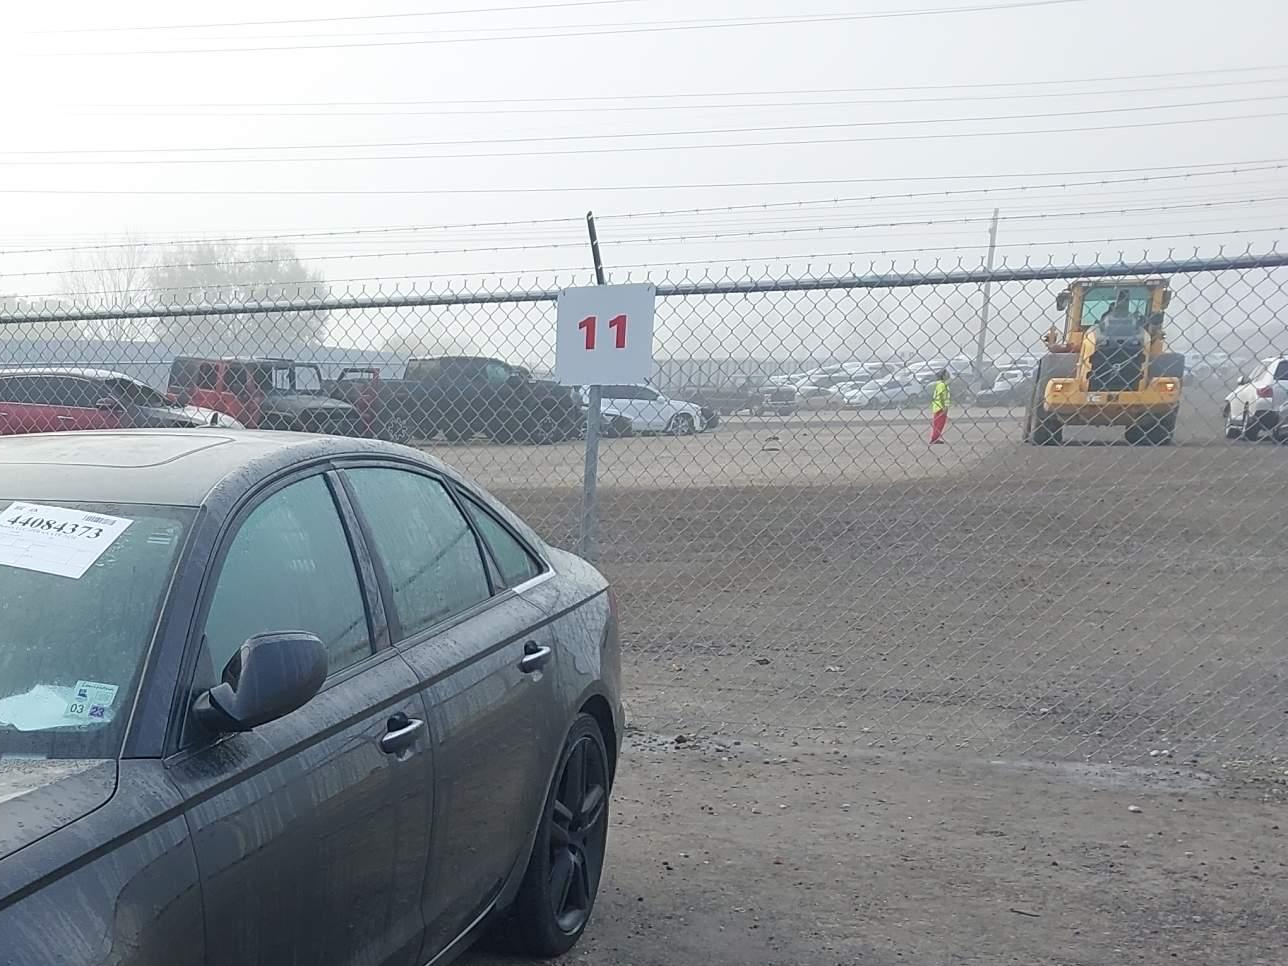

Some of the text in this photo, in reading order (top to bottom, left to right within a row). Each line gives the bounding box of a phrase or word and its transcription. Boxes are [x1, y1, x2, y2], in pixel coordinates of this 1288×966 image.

[578, 314, 627, 349] 11
[7, 514, 104, 540] 44084373
[70, 703, 105, 718] 03 23
